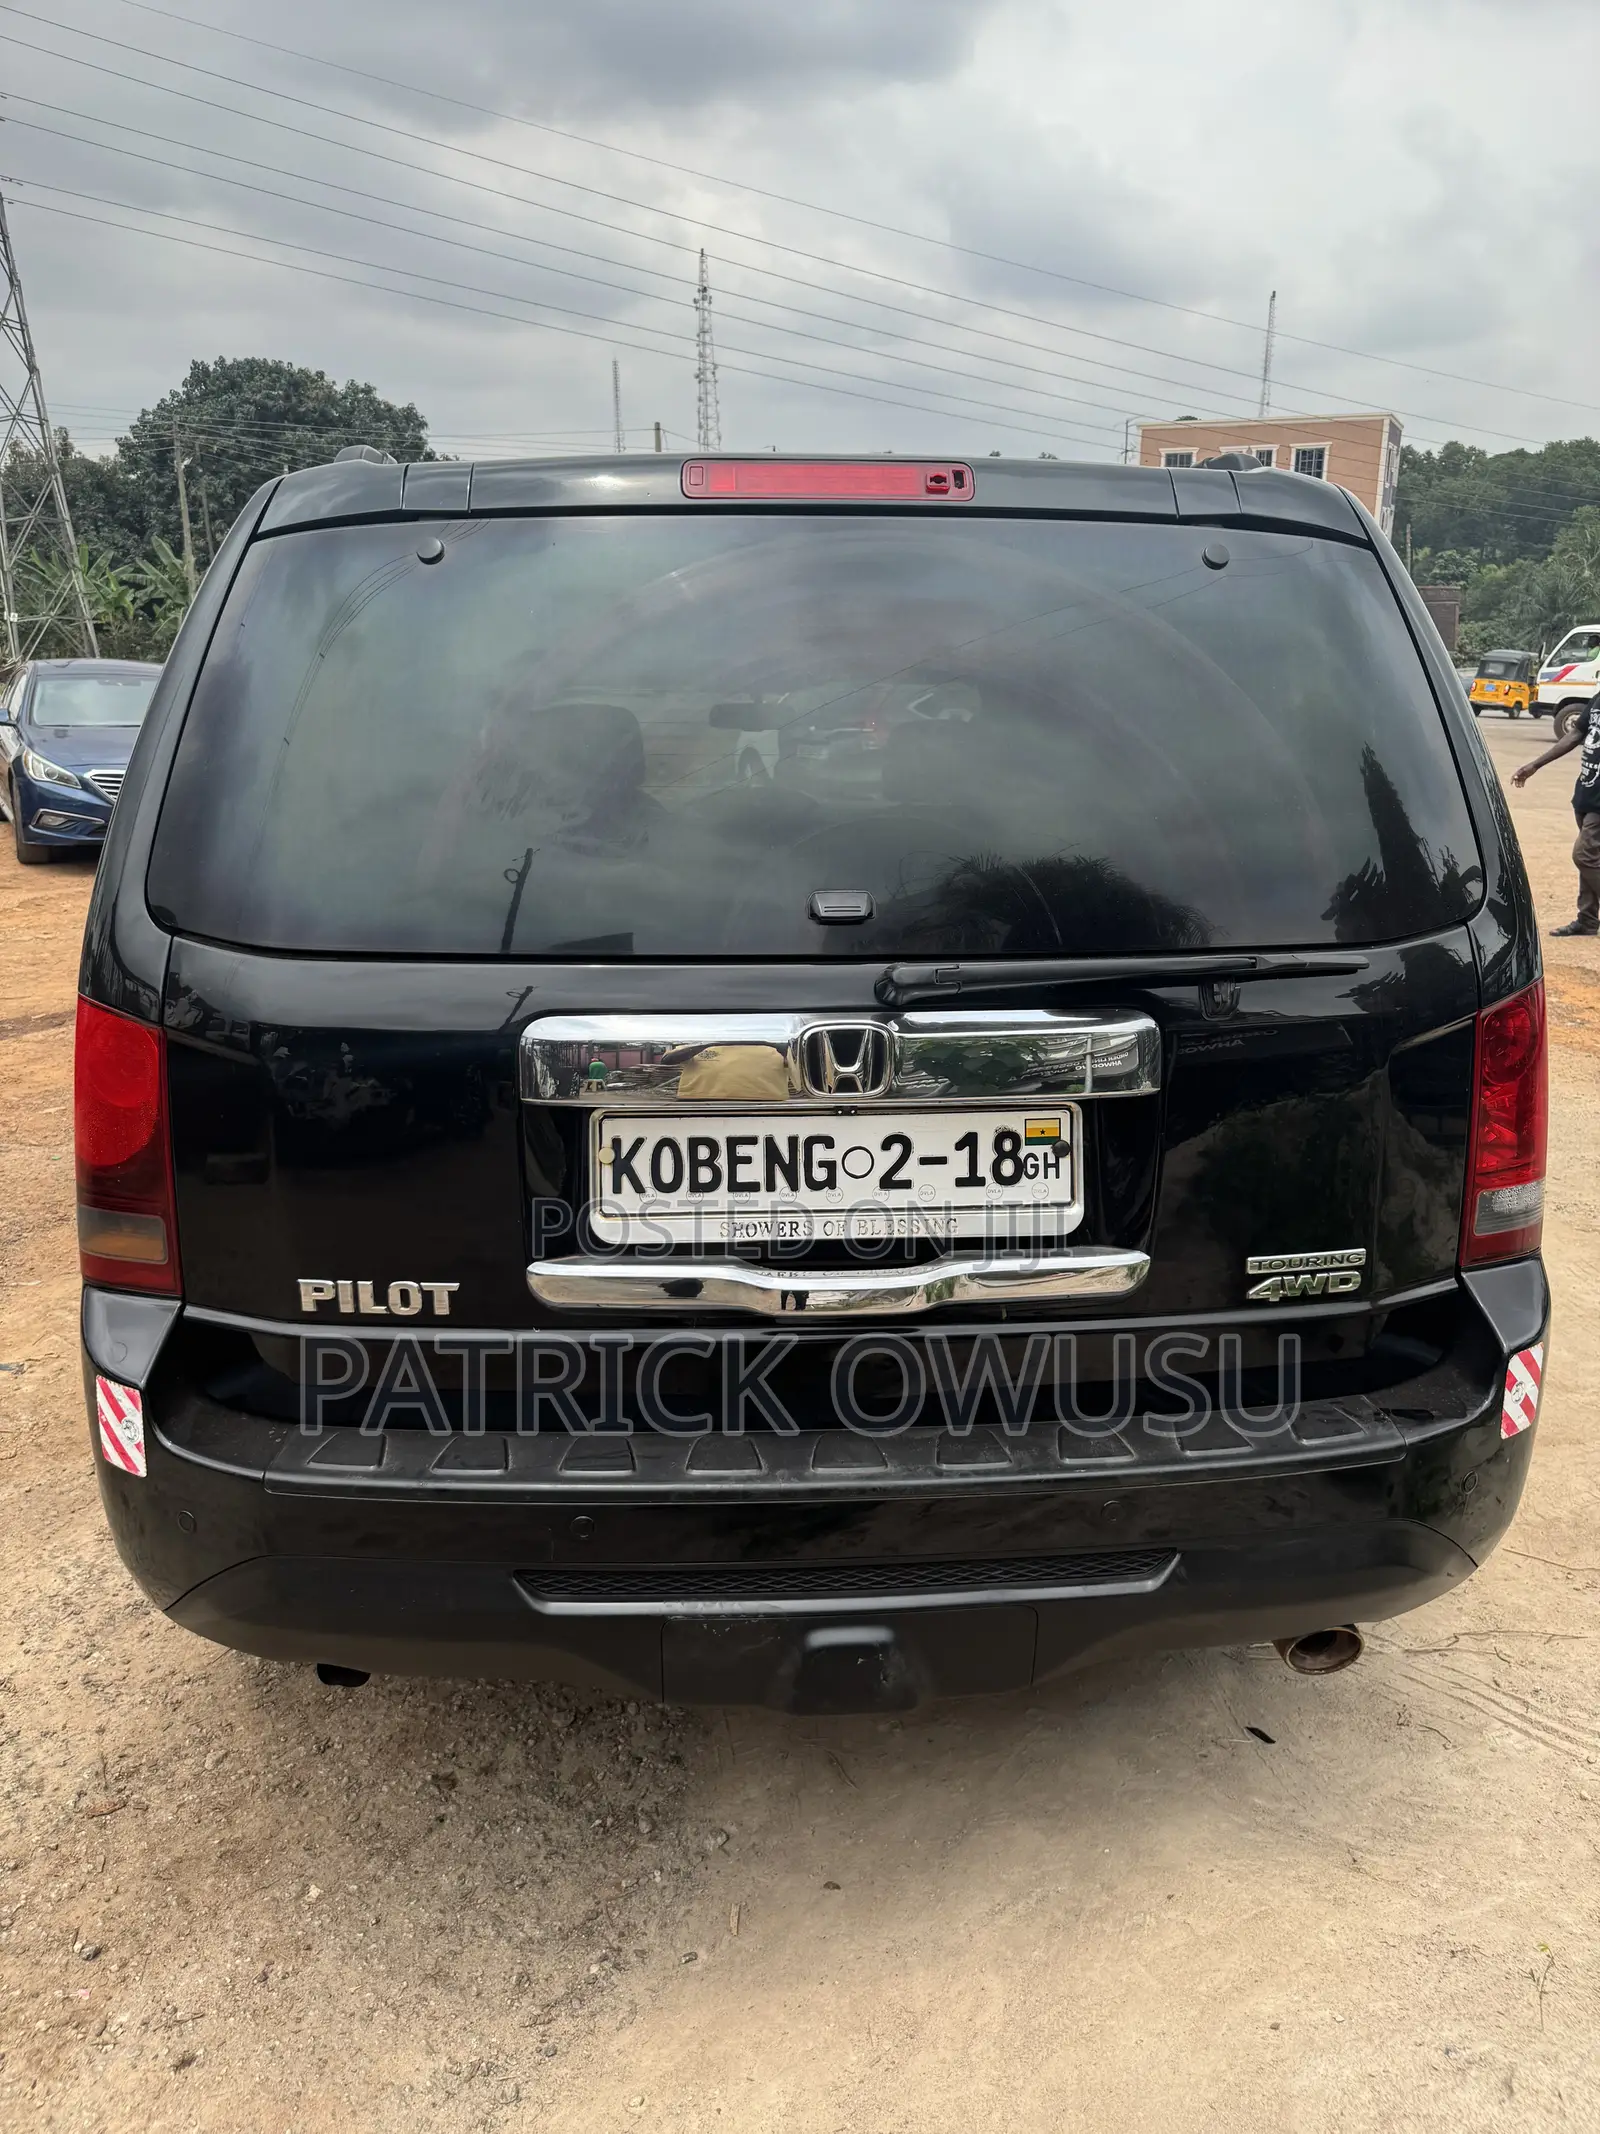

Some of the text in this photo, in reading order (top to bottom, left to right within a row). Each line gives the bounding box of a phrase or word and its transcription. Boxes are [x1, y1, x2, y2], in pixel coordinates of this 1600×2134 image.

[611, 1131, 1024, 1194] KOBENG 2-18
[1022, 1152, 1060, 1180] GH
[719, 1217, 960, 1239] SHOWERS OF BLESSING
[1252, 1252, 1363, 1271] TOURING
[297, 1278, 461, 1316] PILOT
[1246, 1270, 1362, 1303] 4WD
